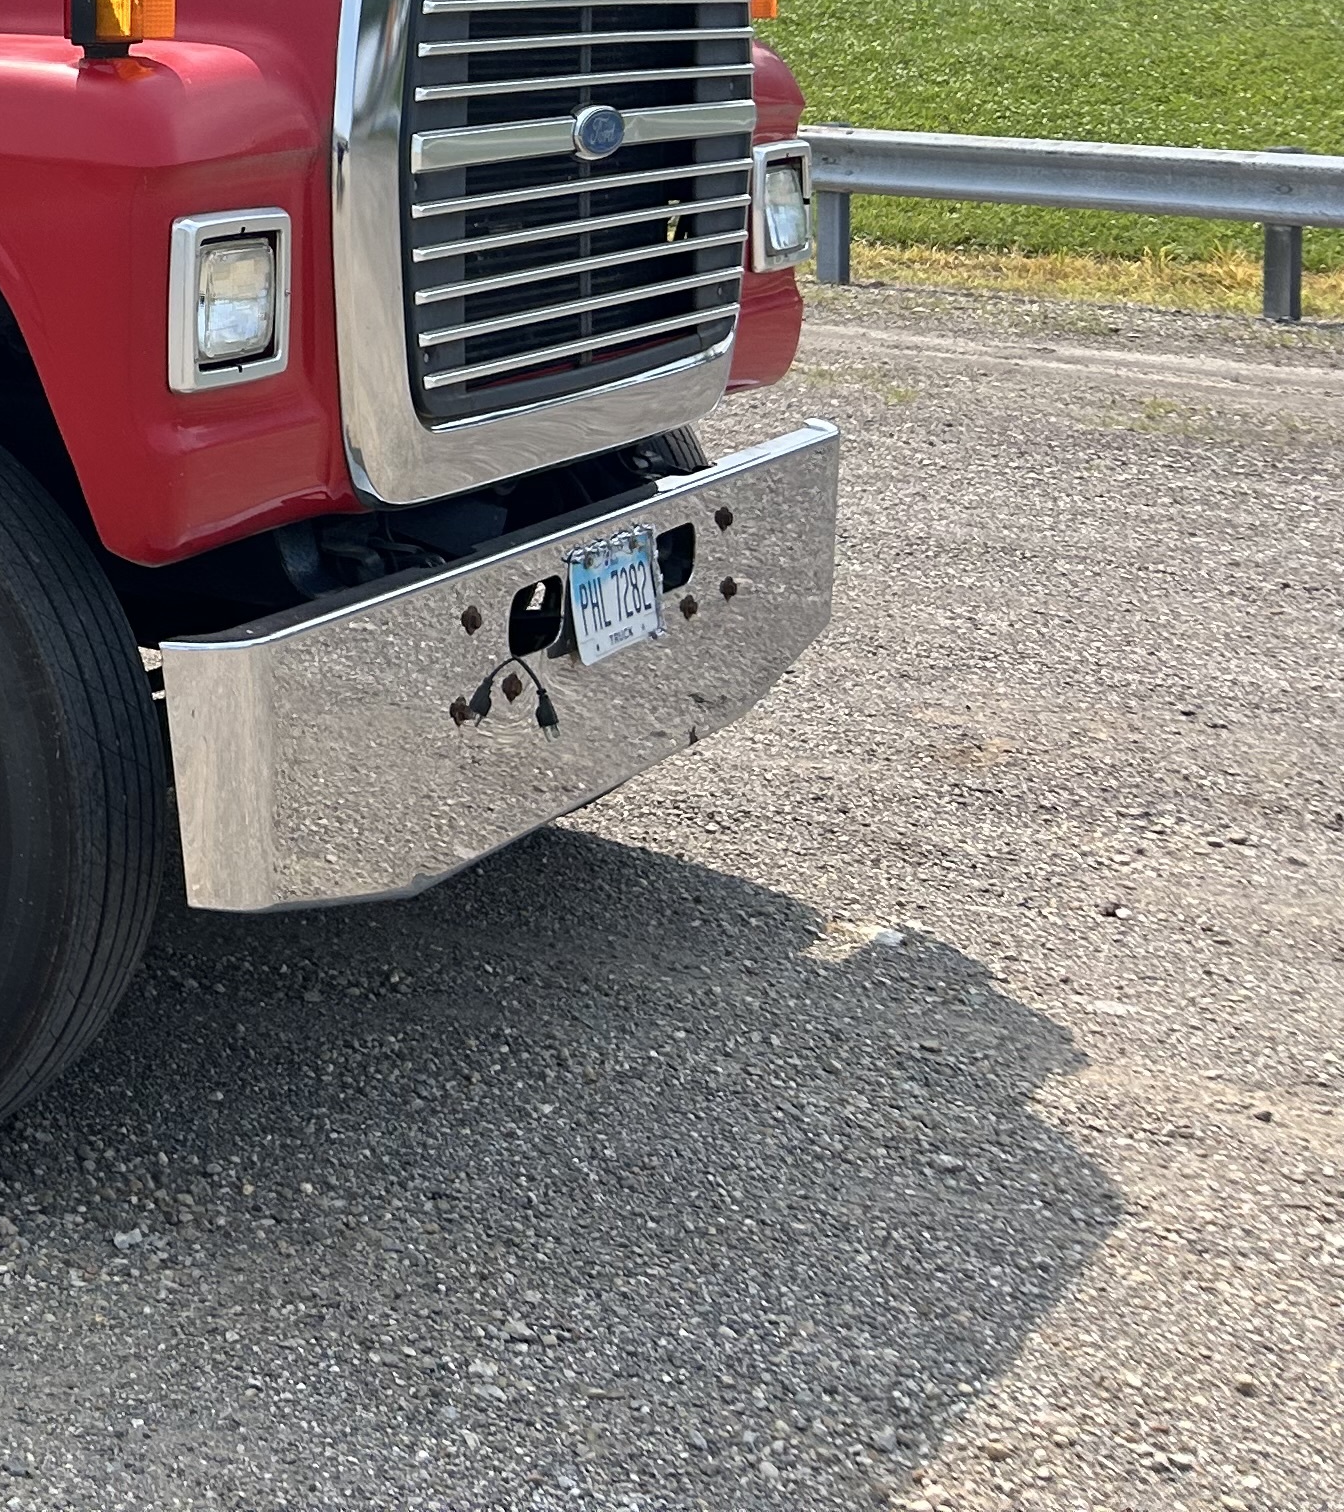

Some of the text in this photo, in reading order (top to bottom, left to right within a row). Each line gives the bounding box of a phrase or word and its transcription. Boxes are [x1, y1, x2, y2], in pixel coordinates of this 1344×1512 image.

[588, 116, 617, 146] Ford
[578, 560, 652, 636] PHL 7282
[608, 626, 634, 645] TRUCK
